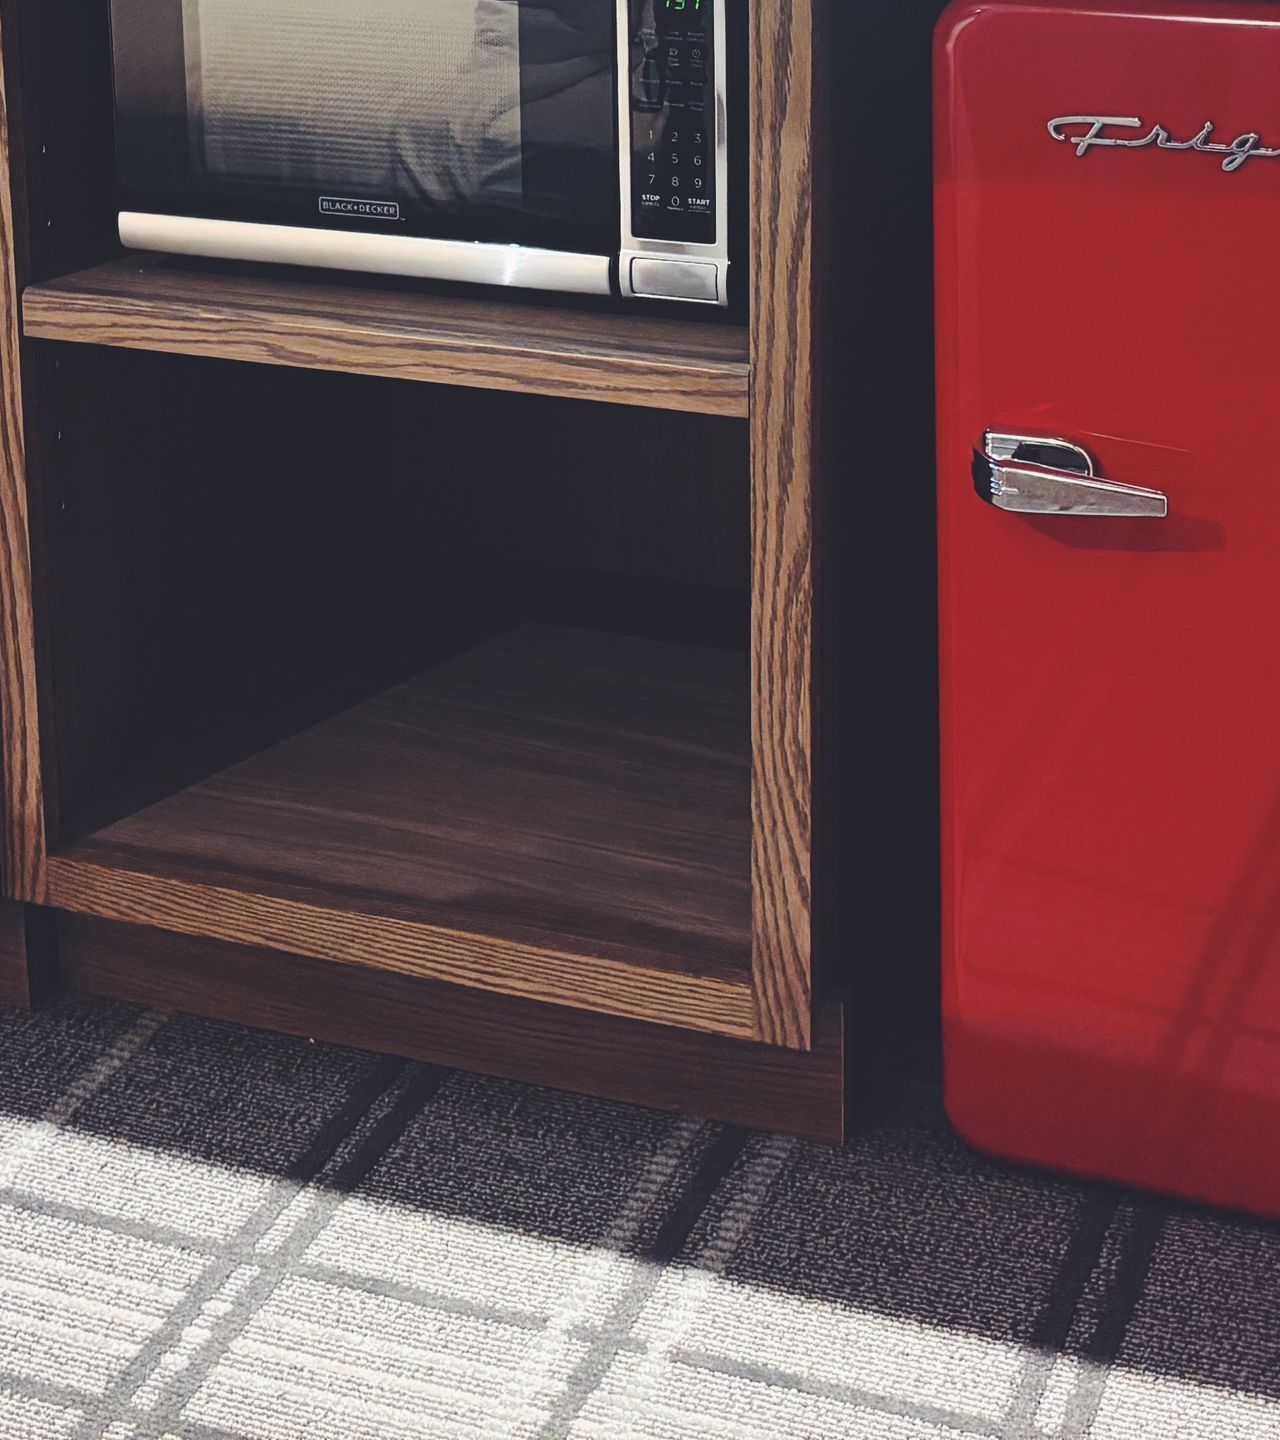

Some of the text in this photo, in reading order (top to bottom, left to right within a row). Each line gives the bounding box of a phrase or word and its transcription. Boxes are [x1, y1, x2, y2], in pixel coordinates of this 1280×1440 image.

[671, 131, 678, 142] 2
[694, 133, 701, 144] 3
[647, 152, 701, 166] 4 5 6
[648, 174, 702, 189] 7 8 9
[671, 195, 680, 206] 0
[688, 198, 710, 206] START
